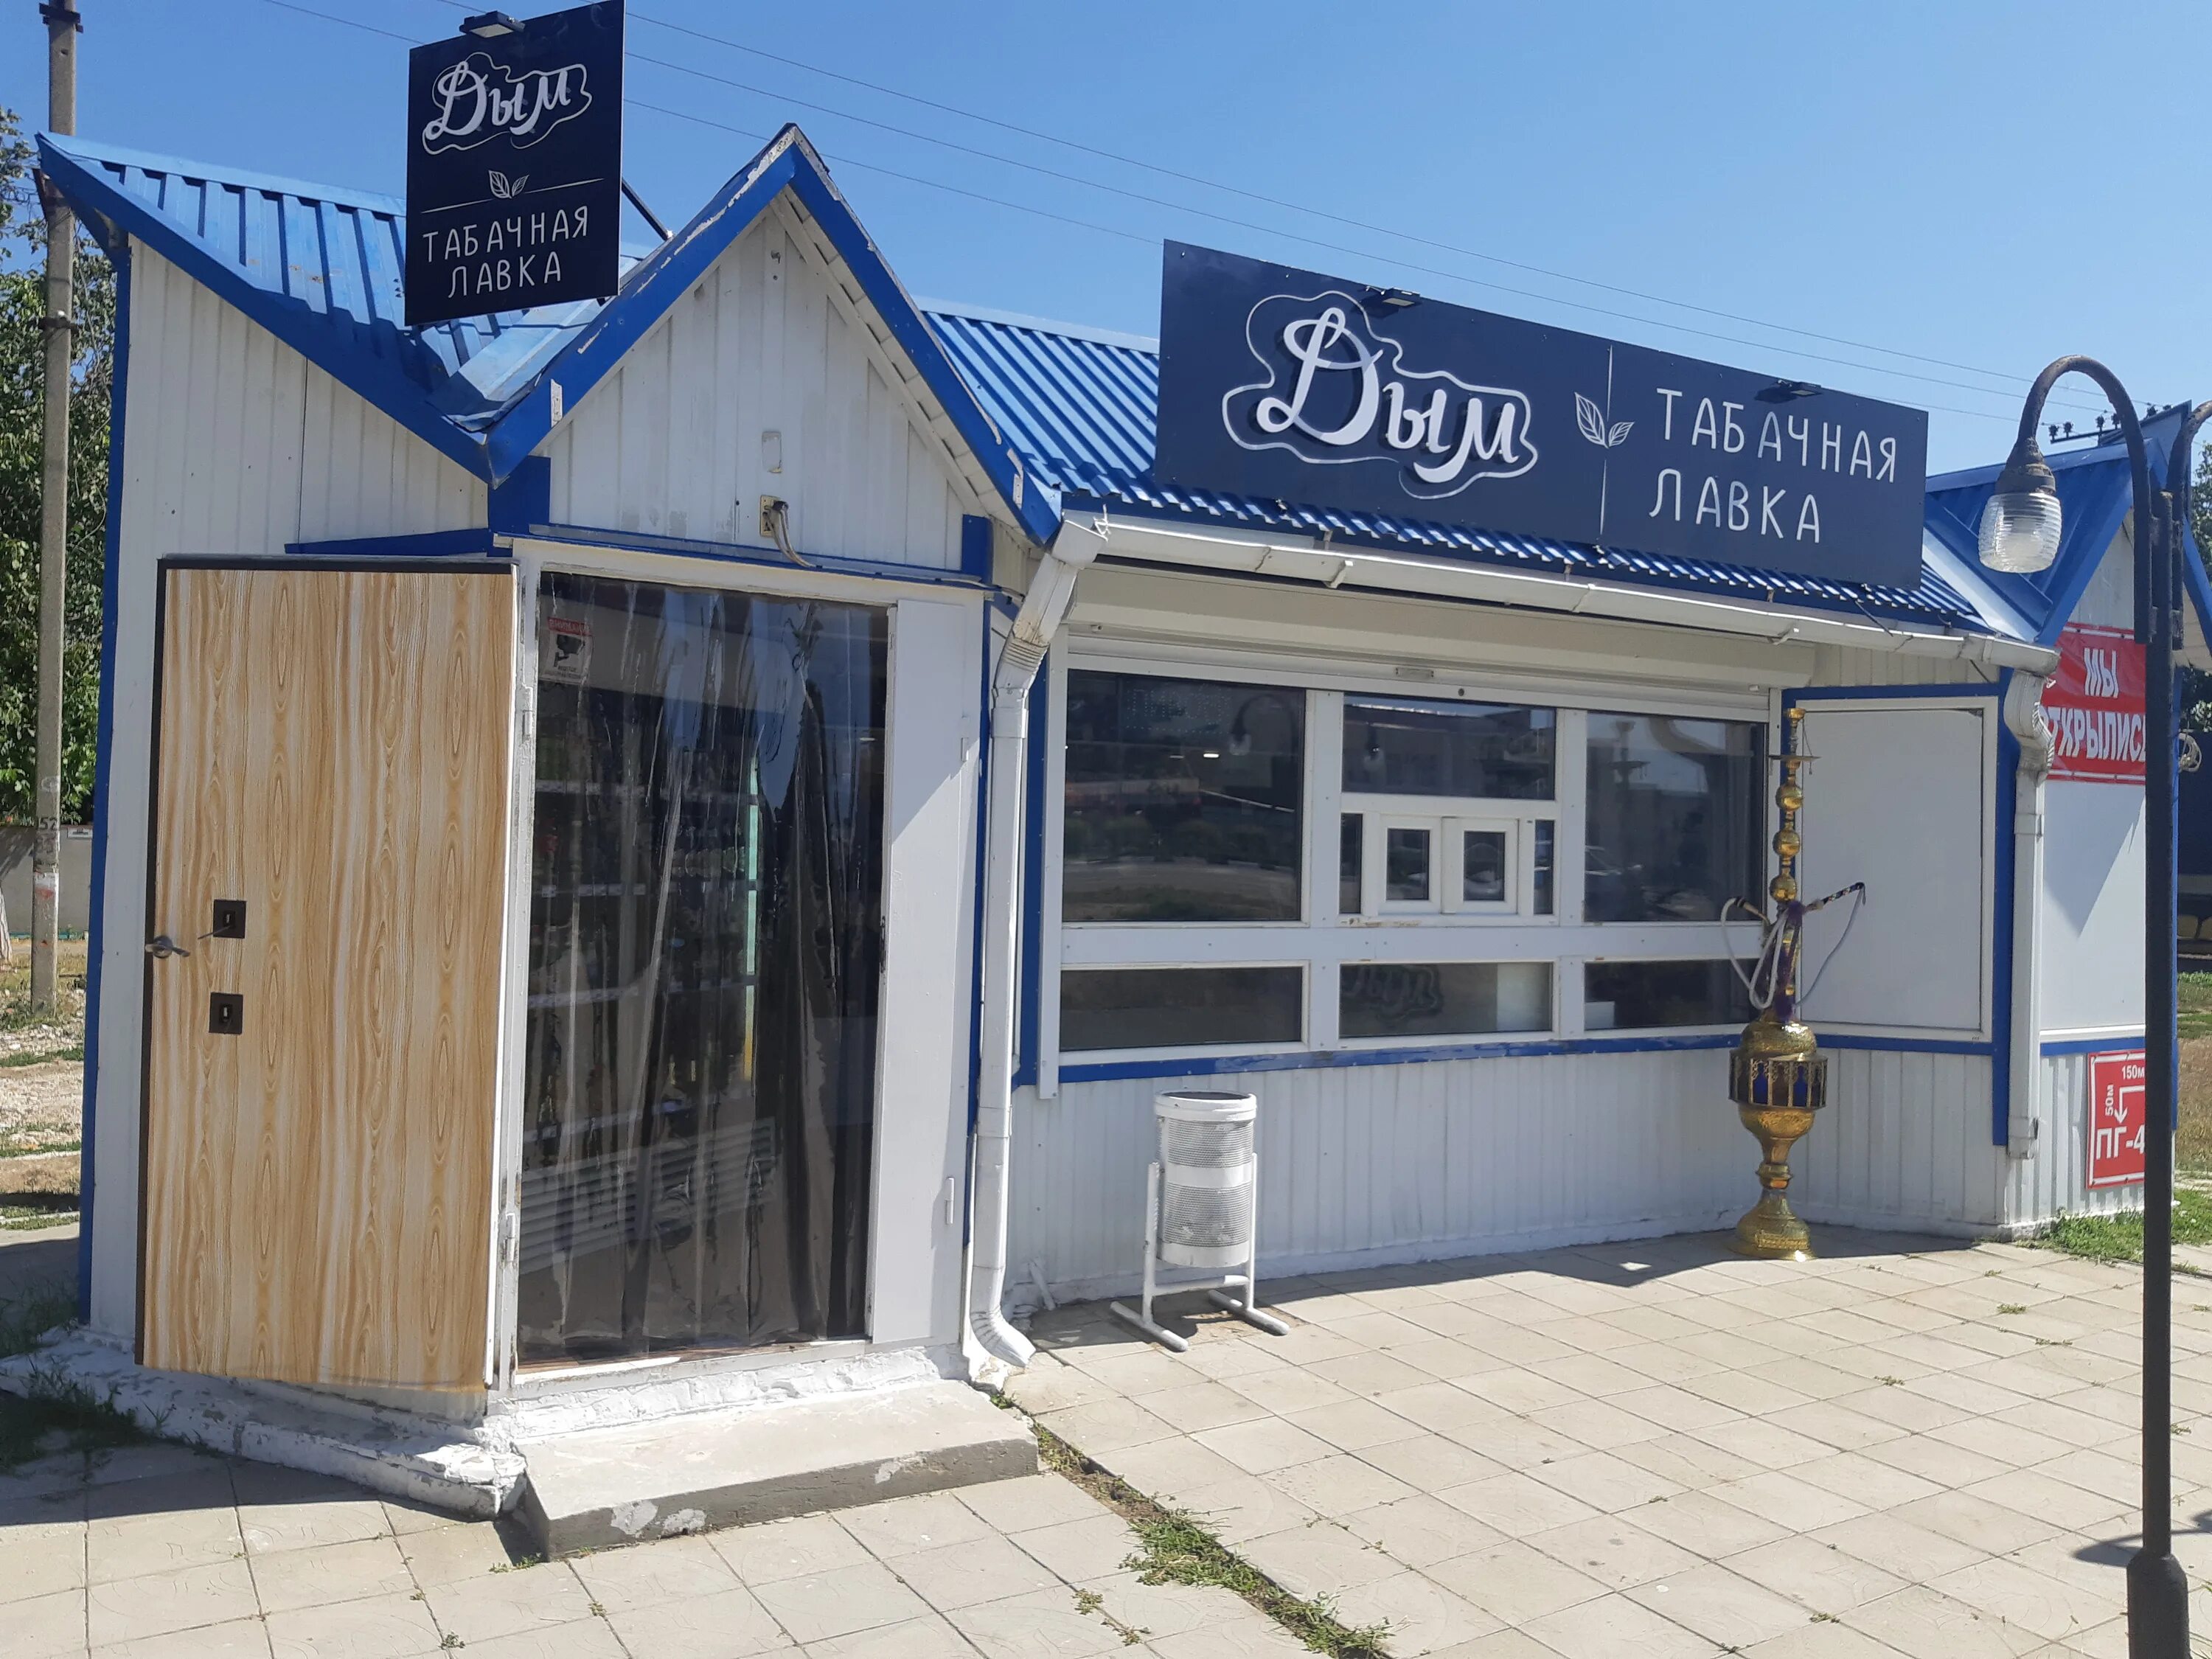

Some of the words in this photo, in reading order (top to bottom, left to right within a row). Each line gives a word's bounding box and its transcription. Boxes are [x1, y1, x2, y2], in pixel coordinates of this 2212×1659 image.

[425, 61, 571, 140] Дым
[422, 206, 588, 263] ТАБАЧНАЯ
[448, 251, 562, 298] ЛАВКА
[1256, 307, 1520, 483] Дым
[1657, 388, 1896, 483] ТАБАЧНАЯ
[1649, 468, 1820, 543] ЛАВКА
[2084, 647, 2119, 698] МЫ
[2096, 1124, 2145, 1160] ПГ-4
